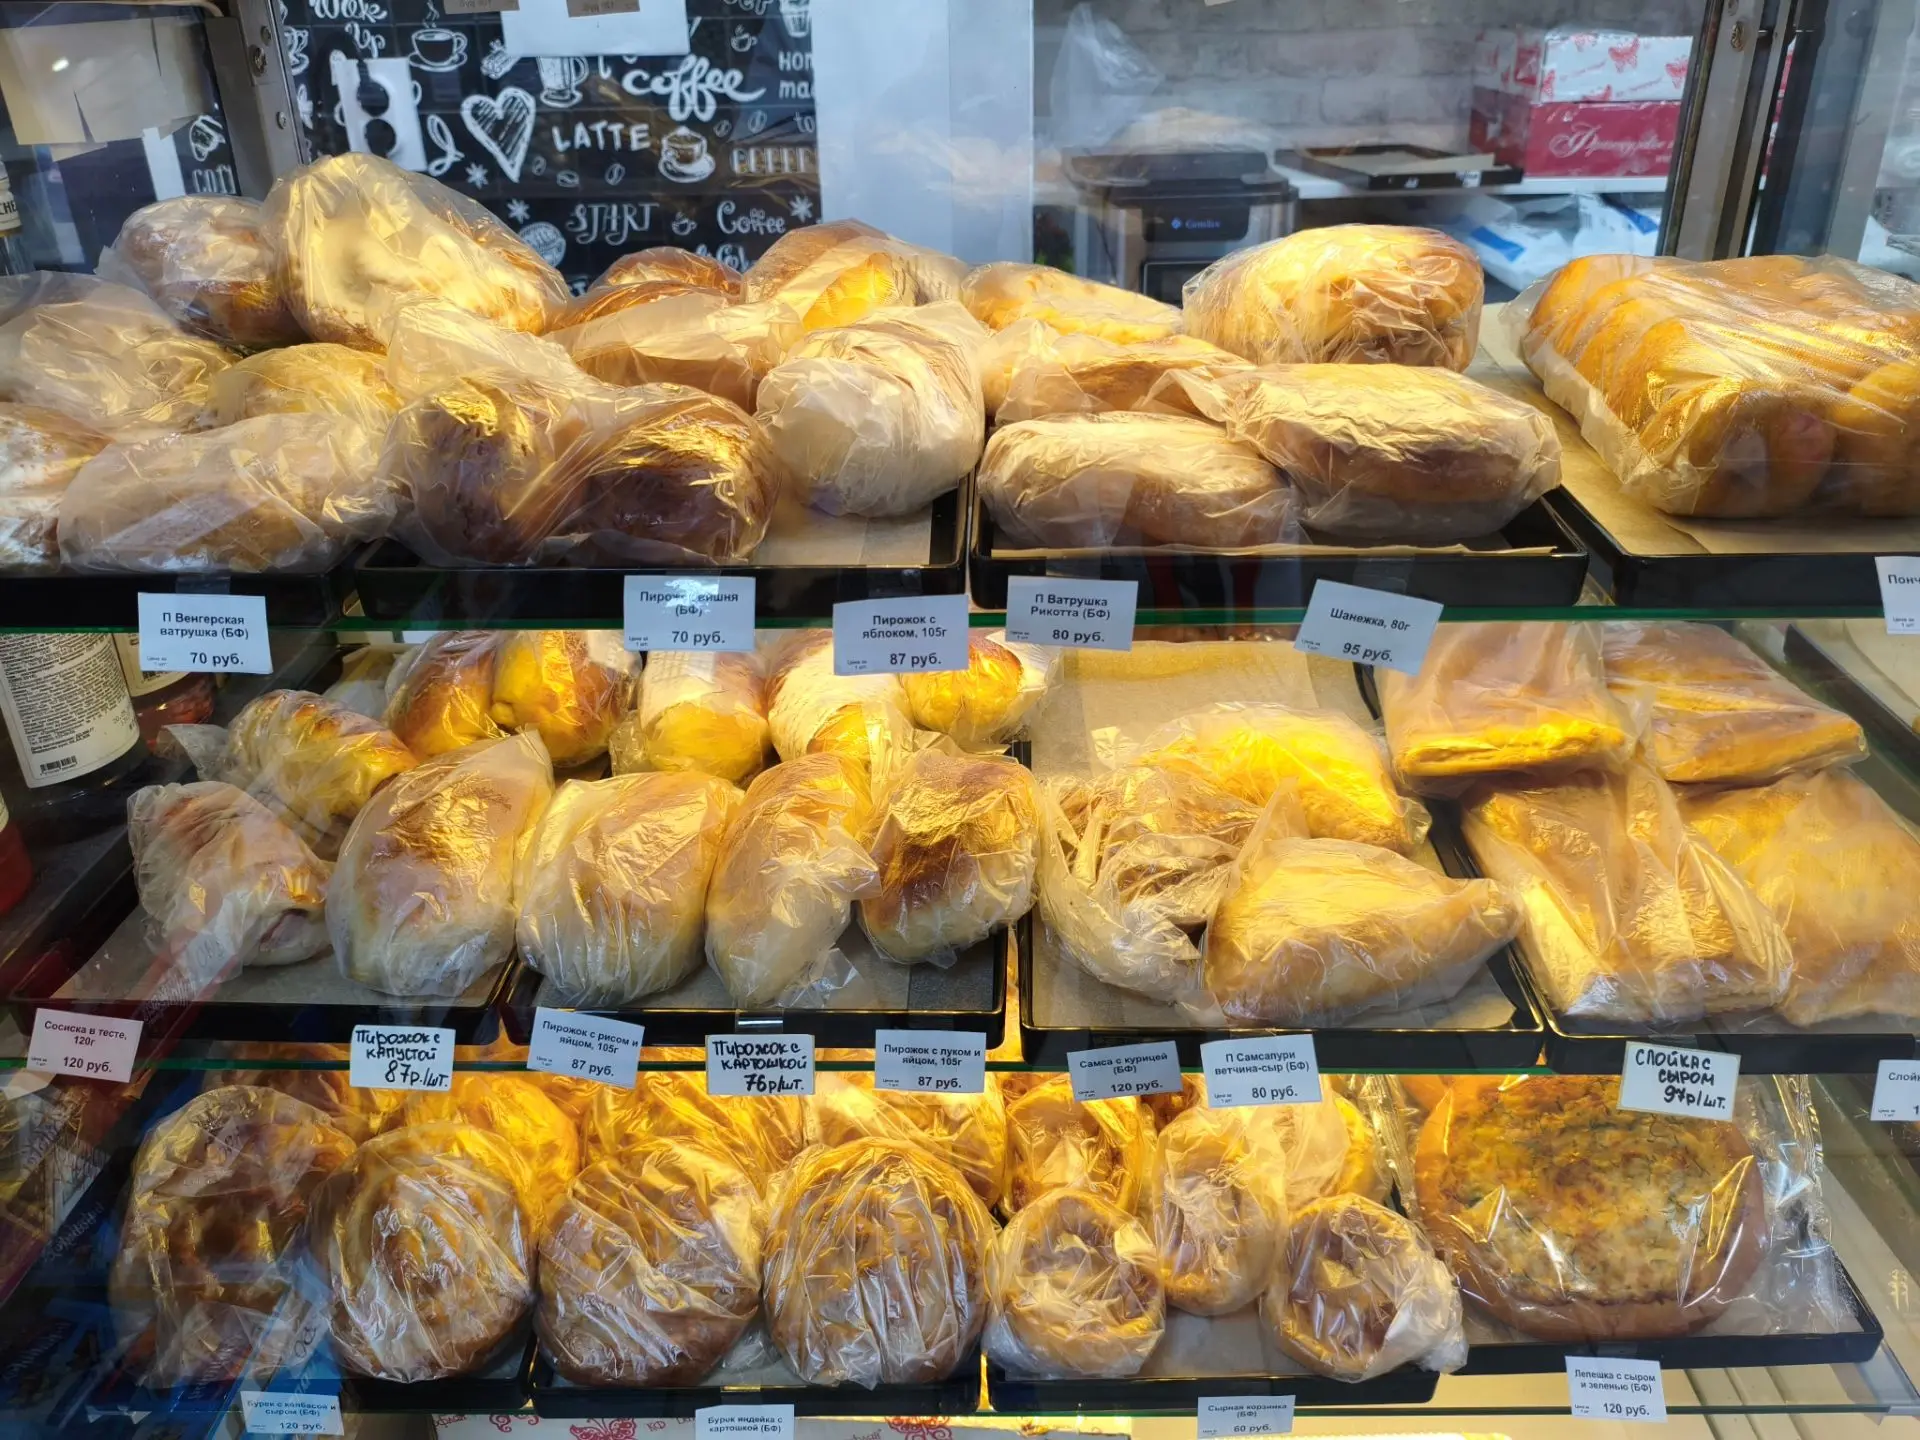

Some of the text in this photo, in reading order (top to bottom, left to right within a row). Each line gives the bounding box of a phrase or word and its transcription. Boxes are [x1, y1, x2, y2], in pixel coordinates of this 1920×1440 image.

[621, 53, 766, 122] coffee
[551, 120, 650, 152] LATTE
[566, 202, 660, 246] START
[717, 200, 787, 235] Coffee
[1035, 594, 1108, 608] П Ватрушка
[675, 604, 703, 617] (БФ)
[1030, 605, 1111, 620] Рикотта (БФ)
[163, 612, 245, 625] П Венгерская
[873, 615, 936, 627] Пирожок с
[1330, 607, 1411, 631] Шанежка, 80г
[160, 627, 249, 640] ватрушка (БФ)
[672, 631, 726, 646] 70 руб.
[862, 627, 947, 639] яблоком, 105г
[1052, 629, 1105, 643] 80 руб.
[1343, 642, 1393, 662] 95 руб.
[190, 652, 244, 667] 70 руб.
[890, 652, 942, 668] 87 руб.
[44, 1020, 127, 1040] Сосиска в тесте,
[542, 1020, 588, 1037] Пирожок
[598, 1033, 629, 1046] рисом
[74, 1036, 96, 1047] 120г
[559, 1036, 619, 1054] яйцом, 105г
[884, 1044, 929, 1056] Пирожок
[940, 1049, 971, 1057] луком
[1225, 1051, 1296, 1062] П Самсапури
[63, 1056, 112, 1073] 120 руб.
[571, 1058, 614, 1076] 87 руб.
[902, 1056, 963, 1066] яйцом, 105г
[1080, 1059, 1113, 1068] Самса
[1124, 1052, 1168, 1064] курицей
[1113, 1065, 1137, 1075] (БФ)
[1215, 1061, 1310, 1075] ветчина-сыр (БФ)
[918, 1076, 962, 1090] 87 руб.
[1110, 1080, 1163, 1093] 120 руб.
[1251, 1085, 1298, 1100] 80 руб.
[1624, 1374, 1656, 1382] сыром
[1588, 1382, 1629, 1391] зеленью
[1630, 1383, 1652, 1394] (БФ)
[1207, 1404, 1244, 1412] Сырная
[1603, 1403, 1650, 1416] 120 руб.
[280, 1422, 326, 1431] 120 руб.
[737, 1416, 775, 1424] индейка
[709, 1424, 781, 1433] картошкой (БФ)
[1249, 1424, 1272, 1432] руб.
